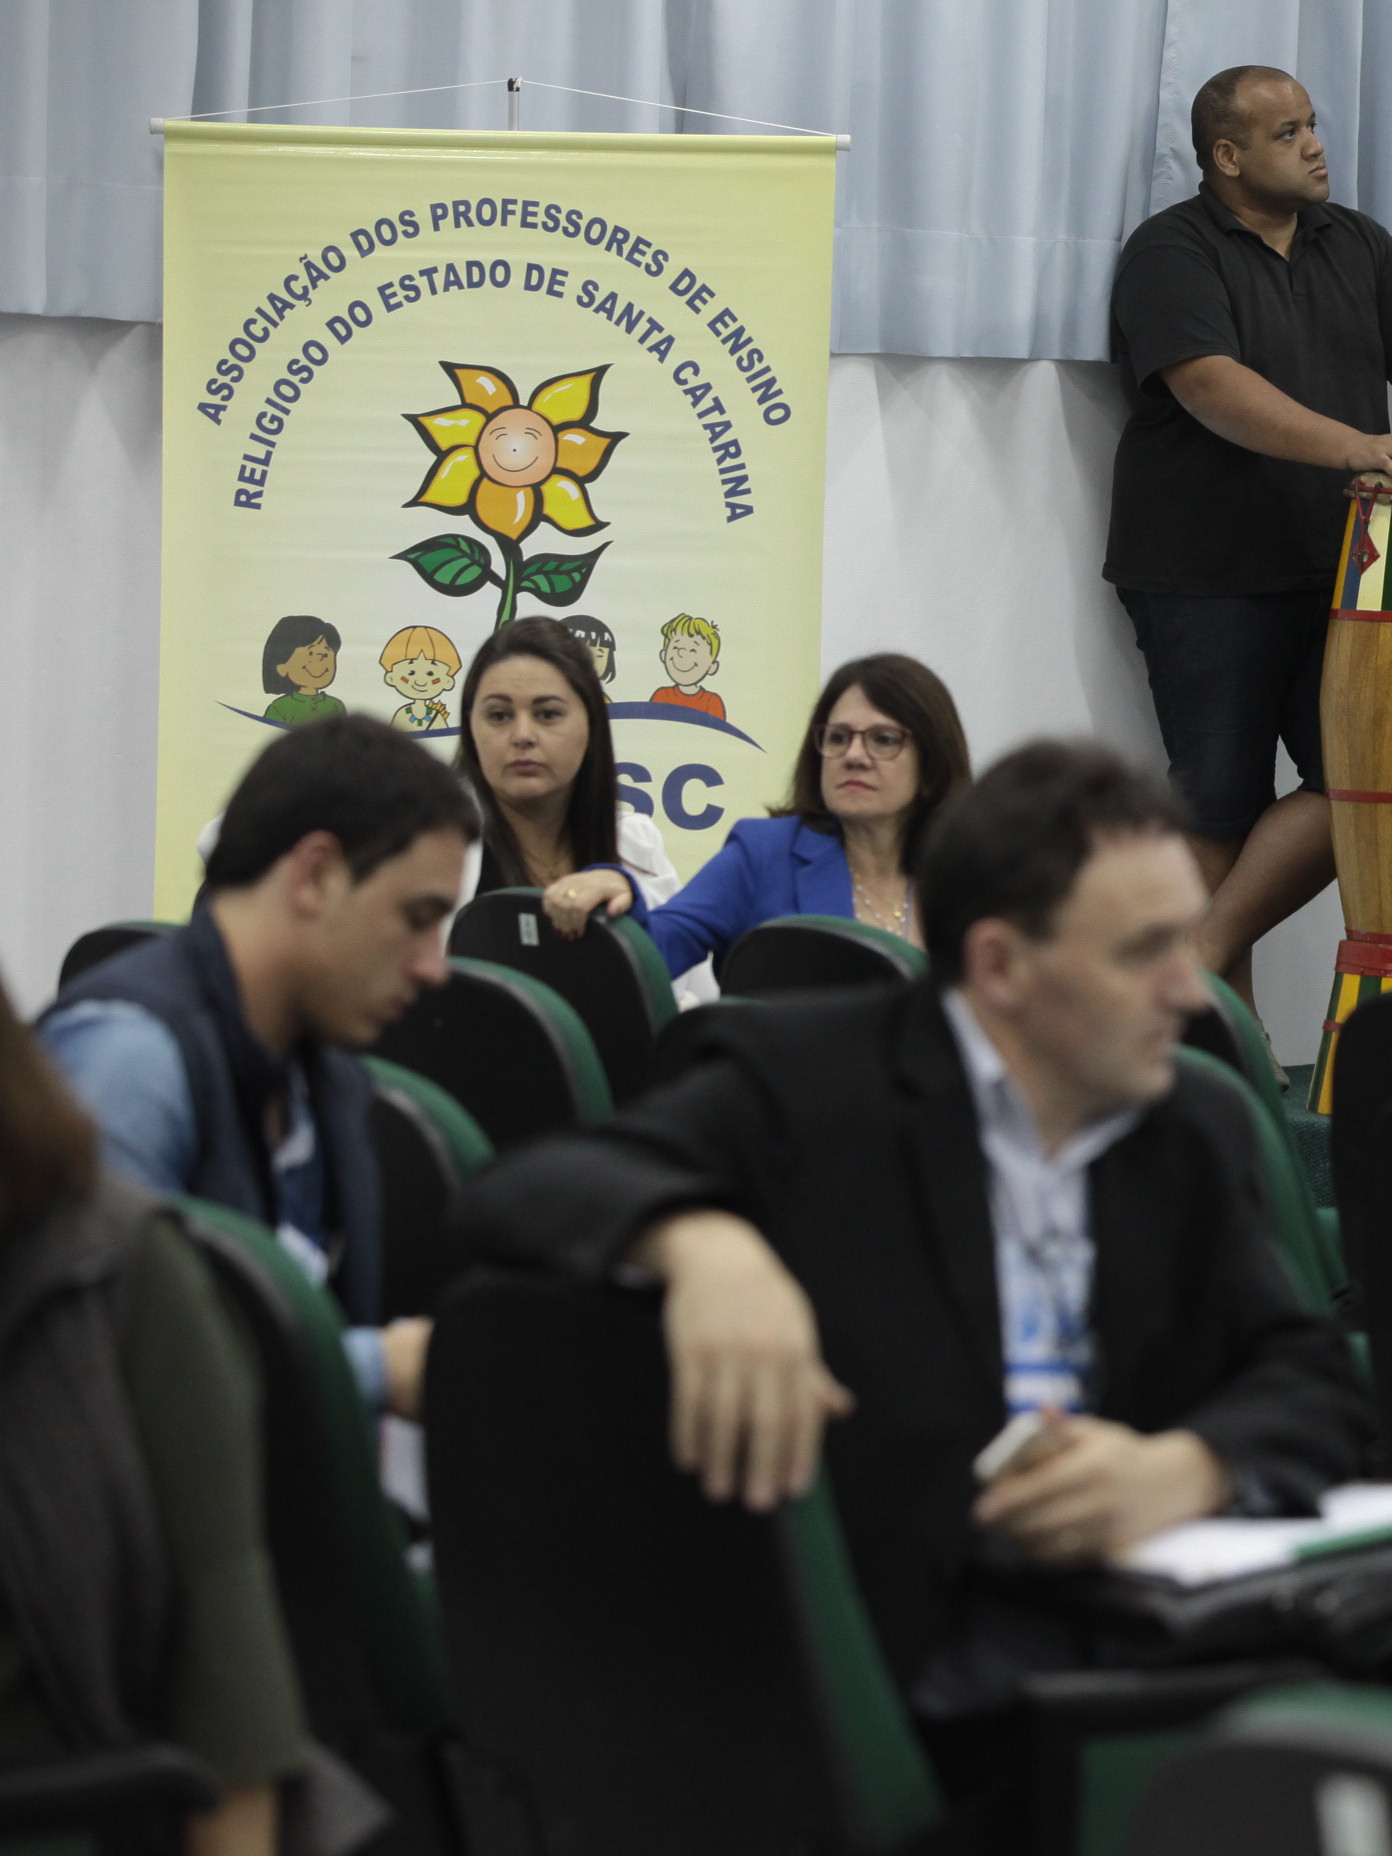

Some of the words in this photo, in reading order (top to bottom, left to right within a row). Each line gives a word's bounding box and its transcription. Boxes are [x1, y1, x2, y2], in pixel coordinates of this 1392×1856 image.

[196, 244, 347, 427] ASSOCIAÇÃO
[349, 209, 421, 259] DOS
[429, 197, 670, 278] PROFESSORES
[667, 267, 717, 316] DE
[706, 306, 792, 427] ENSINO
[233, 339, 330, 511] RELIGIOSO
[324, 299, 374, 346] DO
[376, 258, 512, 314] ESTADO
[523, 262, 570, 299] DE
[575, 279, 676, 365] SANTA
[672, 359, 755, 524] CATARINA
